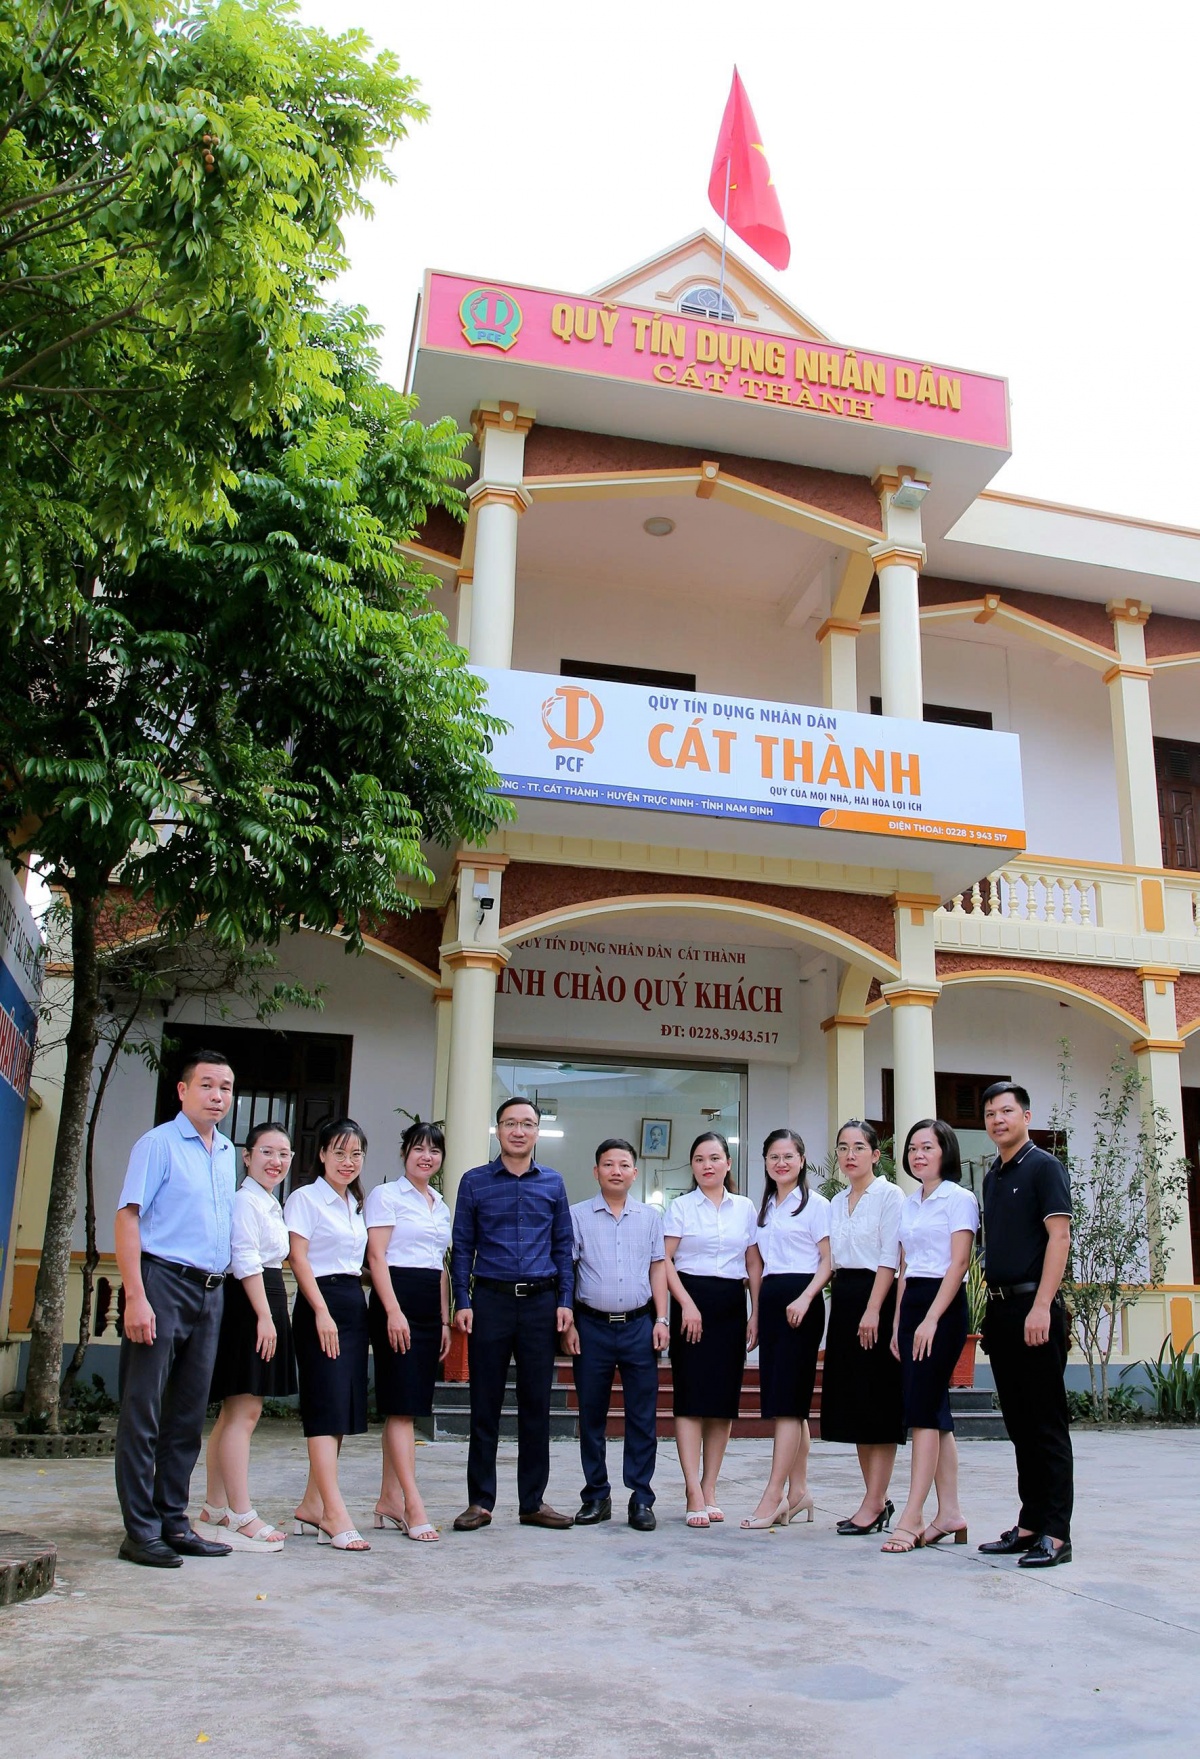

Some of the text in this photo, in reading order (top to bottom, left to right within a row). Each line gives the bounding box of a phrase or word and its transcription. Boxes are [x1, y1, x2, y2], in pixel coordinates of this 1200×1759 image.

[477, 330, 501, 343] PCF
[551, 302, 962, 411] QUỸ TÍN DỤNG NHÂN DÂN
[653, 362, 874, 420] CÁT THÀNH
[684, 698, 707, 714] TÍN
[713, 703, 755, 721] DỤNG
[760, 709, 801, 726] NHÂN
[807, 713, 837, 730] DÂN
[555, 754, 584, 773] PCF
[647, 717, 921, 796] CÁT THÀNH
[527, 782, 541, 792] TT.
[543, 783, 562, 794] CÁT
[564, 785, 599, 798] THÀNH
[607, 791, 640, 803] HUYỆN
[642, 794, 668, 805] TRỰC
[670, 798, 694, 808] NINH
[701, 799, 723, 811] TỈNH
[726, 803, 748, 813] NAM
[749, 807, 773, 816] ĐỊNH
[810, 791, 827, 802] MỌI
[830, 793, 852, 806] NHÀ,
[854, 796, 869, 806] HÀI
[872, 798, 890, 808] HÒA
[892, 801, 906, 812] LỢI
[908, 801, 922, 812] ÍCH
[889, 821, 1008, 842] ĐIỆN THOẠI: 0228 3 943 517
[545, 935, 565, 951] TÍN
[570, 940, 606, 956] DỤNG
[609, 942, 644, 957] NHÂN
[647, 944, 672, 959] DÂN
[678, 946, 701, 961] CÁT
[704, 948, 746, 964] THÀNH
[495, 965, 783, 1013] INH CHÀO QUÝ KHÁCH
[661, 1024, 779, 1045] ĐT: 0228.3943.517
